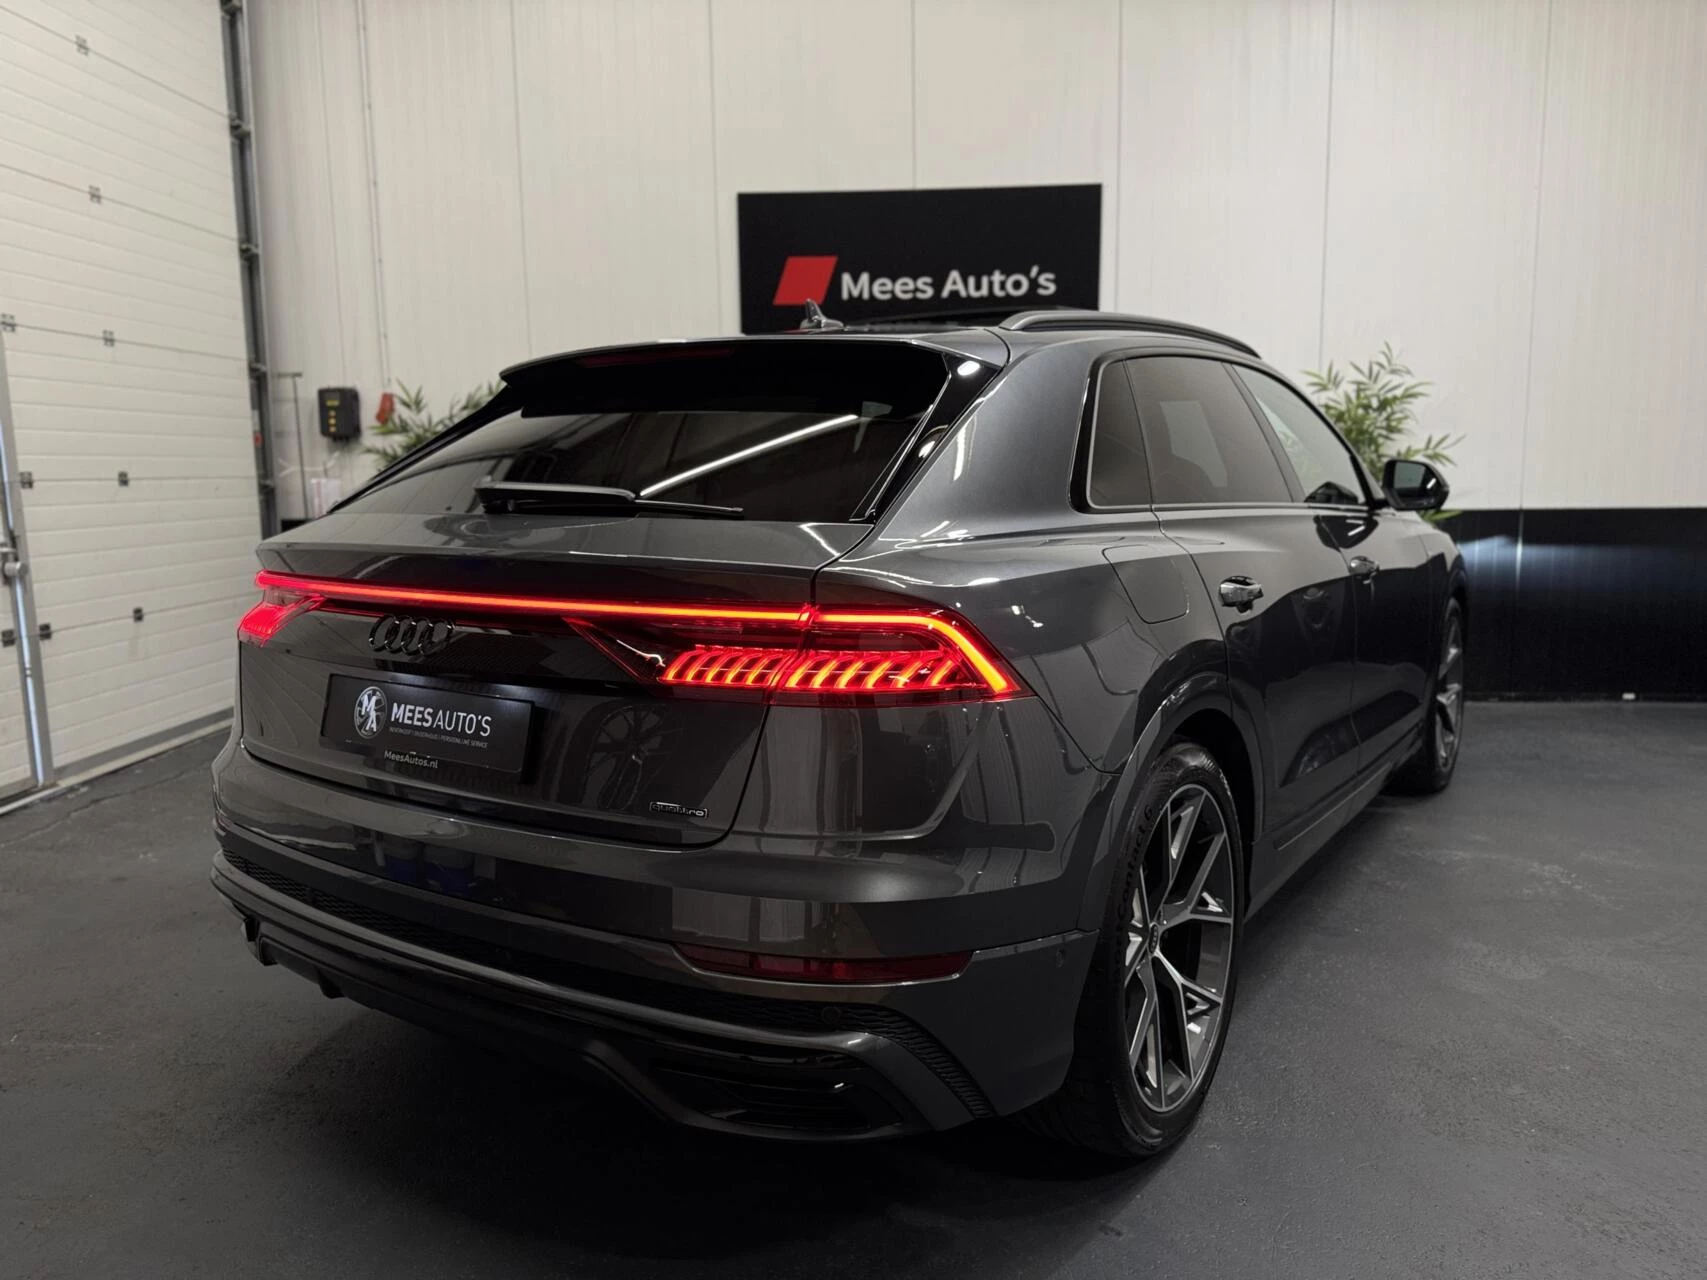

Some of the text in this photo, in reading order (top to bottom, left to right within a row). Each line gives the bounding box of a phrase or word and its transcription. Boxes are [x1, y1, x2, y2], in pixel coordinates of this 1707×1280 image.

[841, 265, 1057, 302] Mees Auto's
[384, 749, 438, 769] MeesAutos.nl
